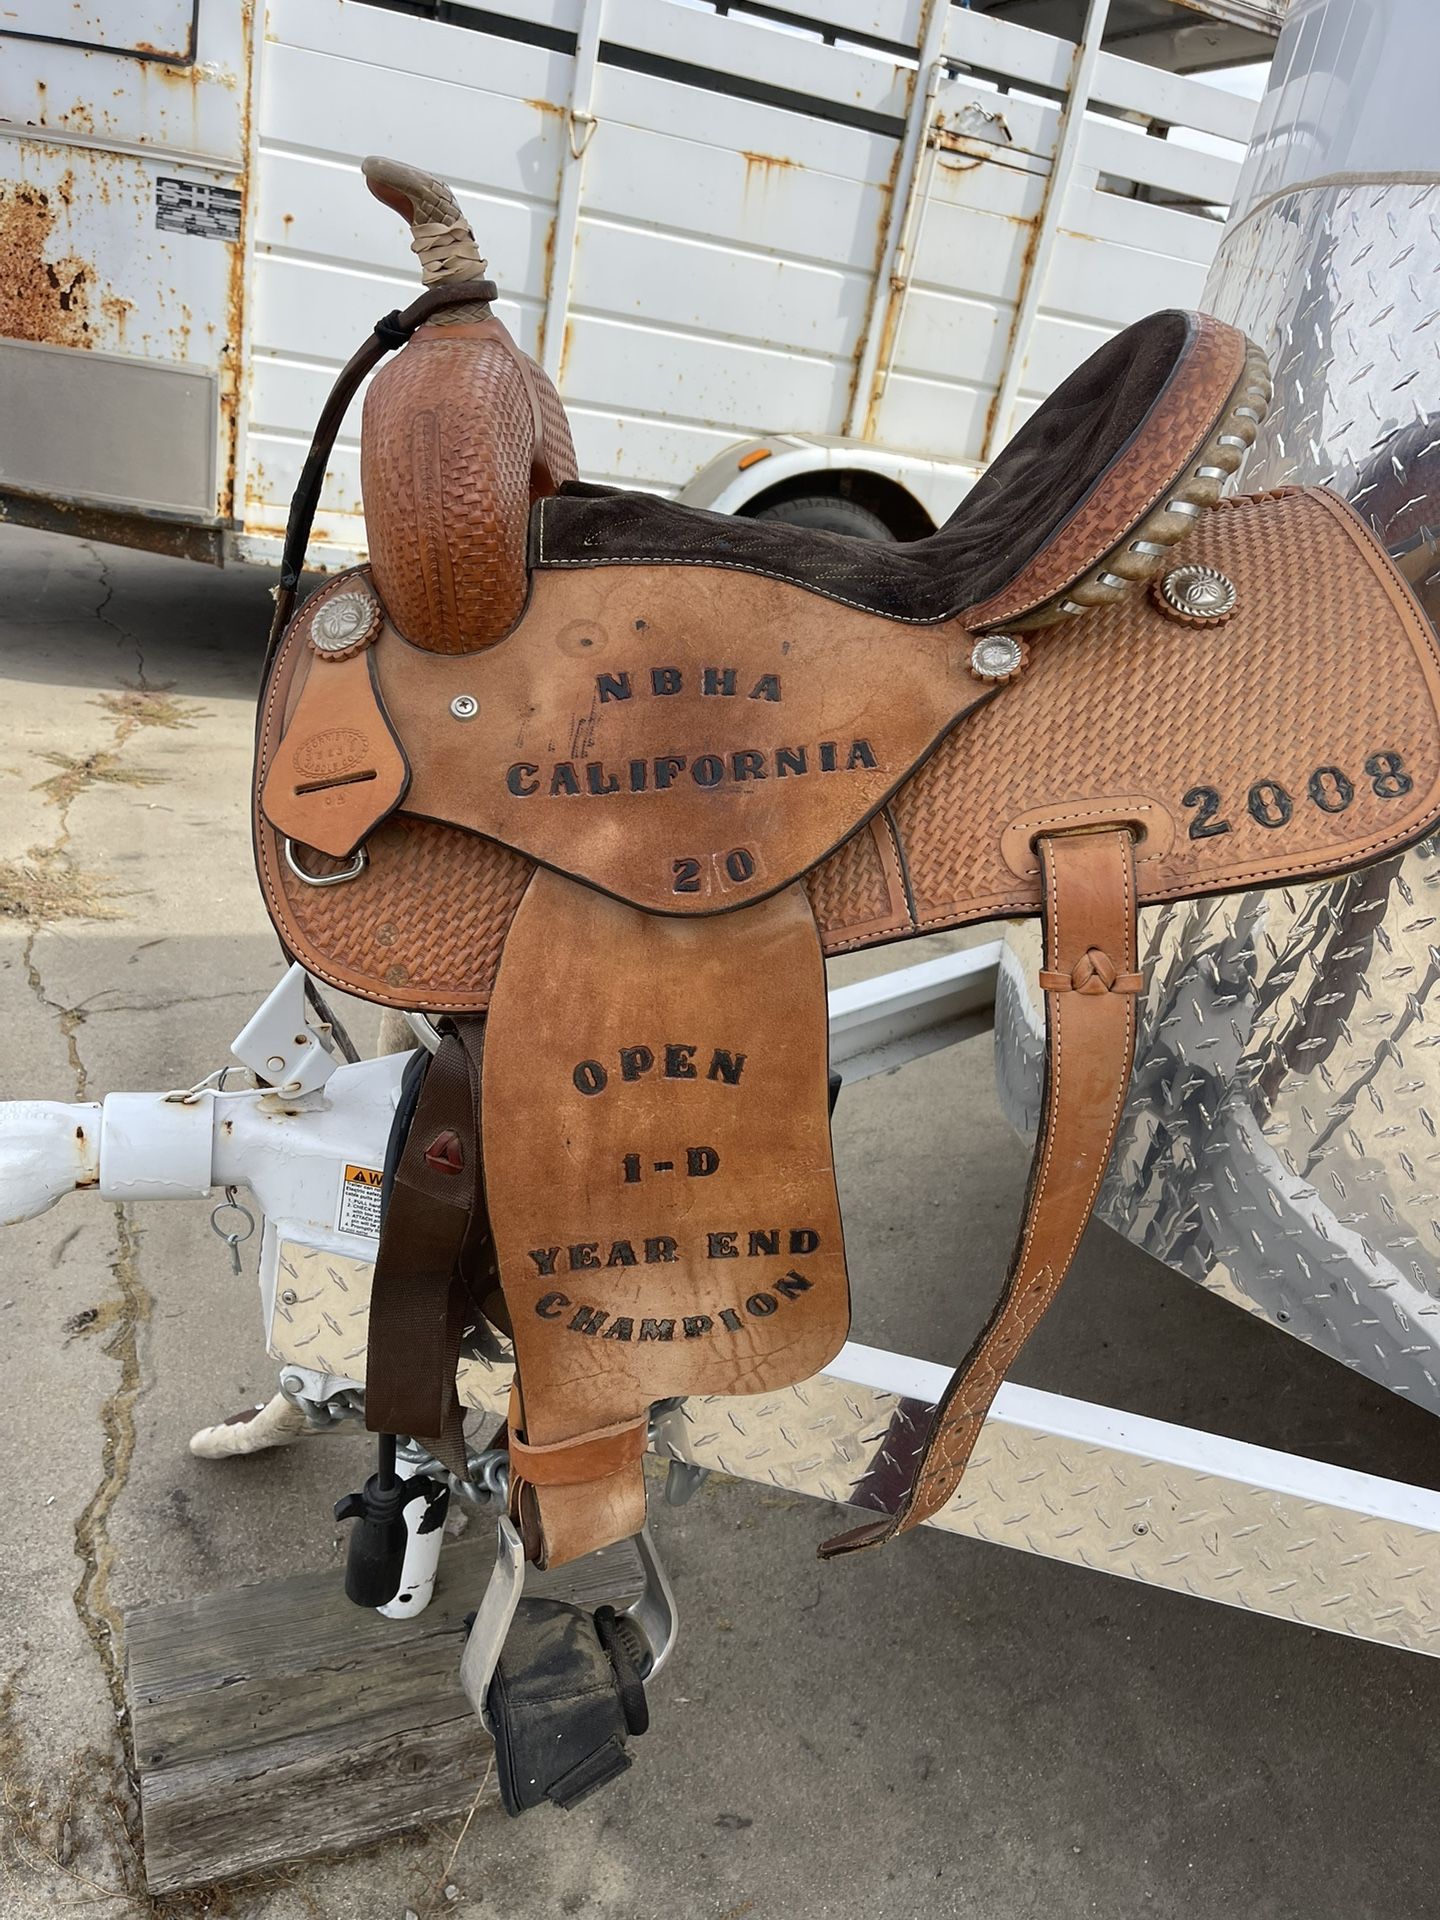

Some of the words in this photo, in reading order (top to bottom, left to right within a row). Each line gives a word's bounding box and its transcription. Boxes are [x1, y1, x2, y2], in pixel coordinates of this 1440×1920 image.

[597, 666, 782, 703] NBHA
[506, 739, 878, 797] CALIFORNIA
[1182, 751, 1414, 841] 2008
[672, 847, 755, 893] 20
[573, 1044, 747, 1096] OPEN
[528, 1236, 679, 1277] YEAR
[707, 1228, 821, 1259] END
[535, 1269, 814, 1341] CHAMPION
